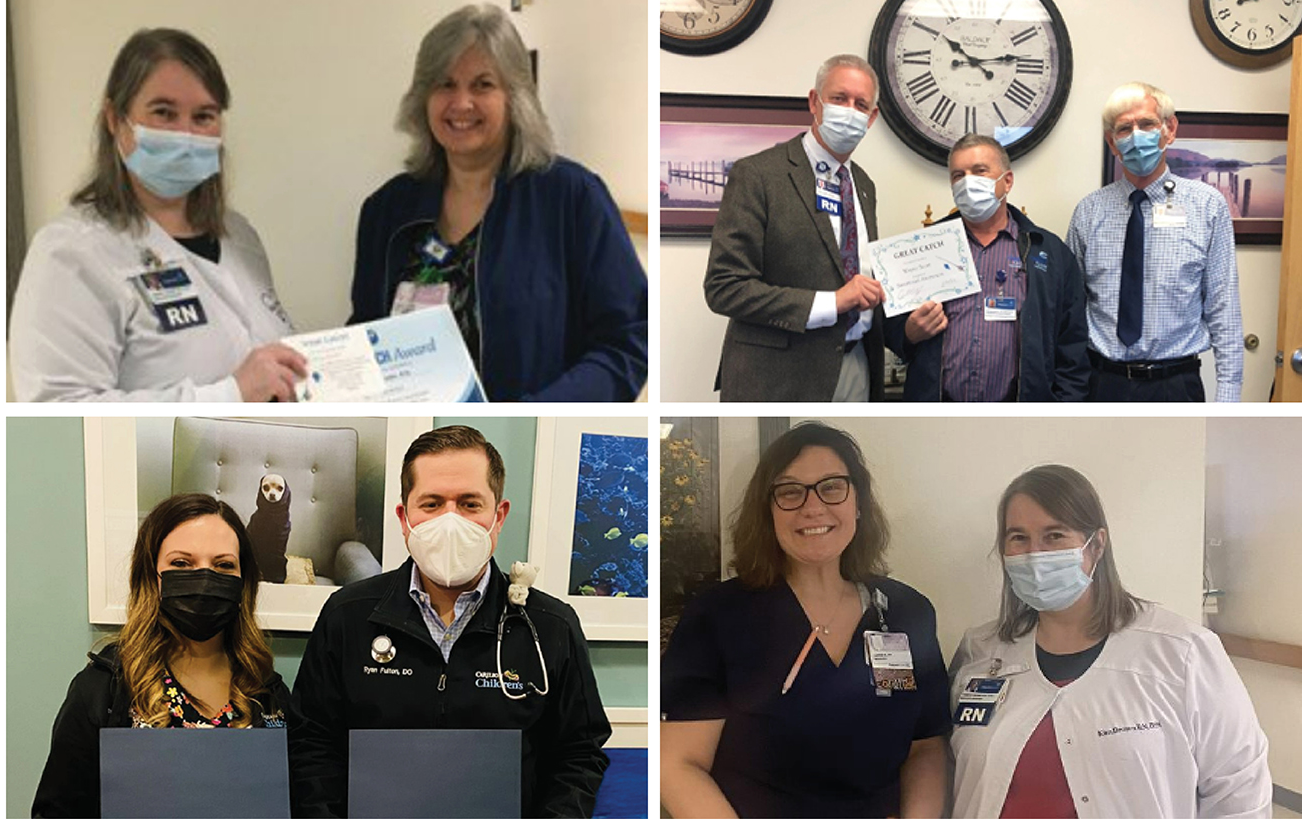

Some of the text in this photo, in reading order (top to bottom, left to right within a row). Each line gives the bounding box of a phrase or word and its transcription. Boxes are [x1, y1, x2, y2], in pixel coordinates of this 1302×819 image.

[684, 12, 696, 30] 6
[708, 6, 720, 24] 5
[1218, 8, 1230, 20] 8
[1230, 21, 1242, 32] 7
[1248, 28, 1257, 41] 6
[822, 199, 838, 213] RN
[894, 240, 944, 259] GREAT CATCH
[166, 304, 198, 326] RN
[394, 338, 437, 362] Award
[380, 667, 400, 676] Fulton,
[960, 708, 986, 721] RN
